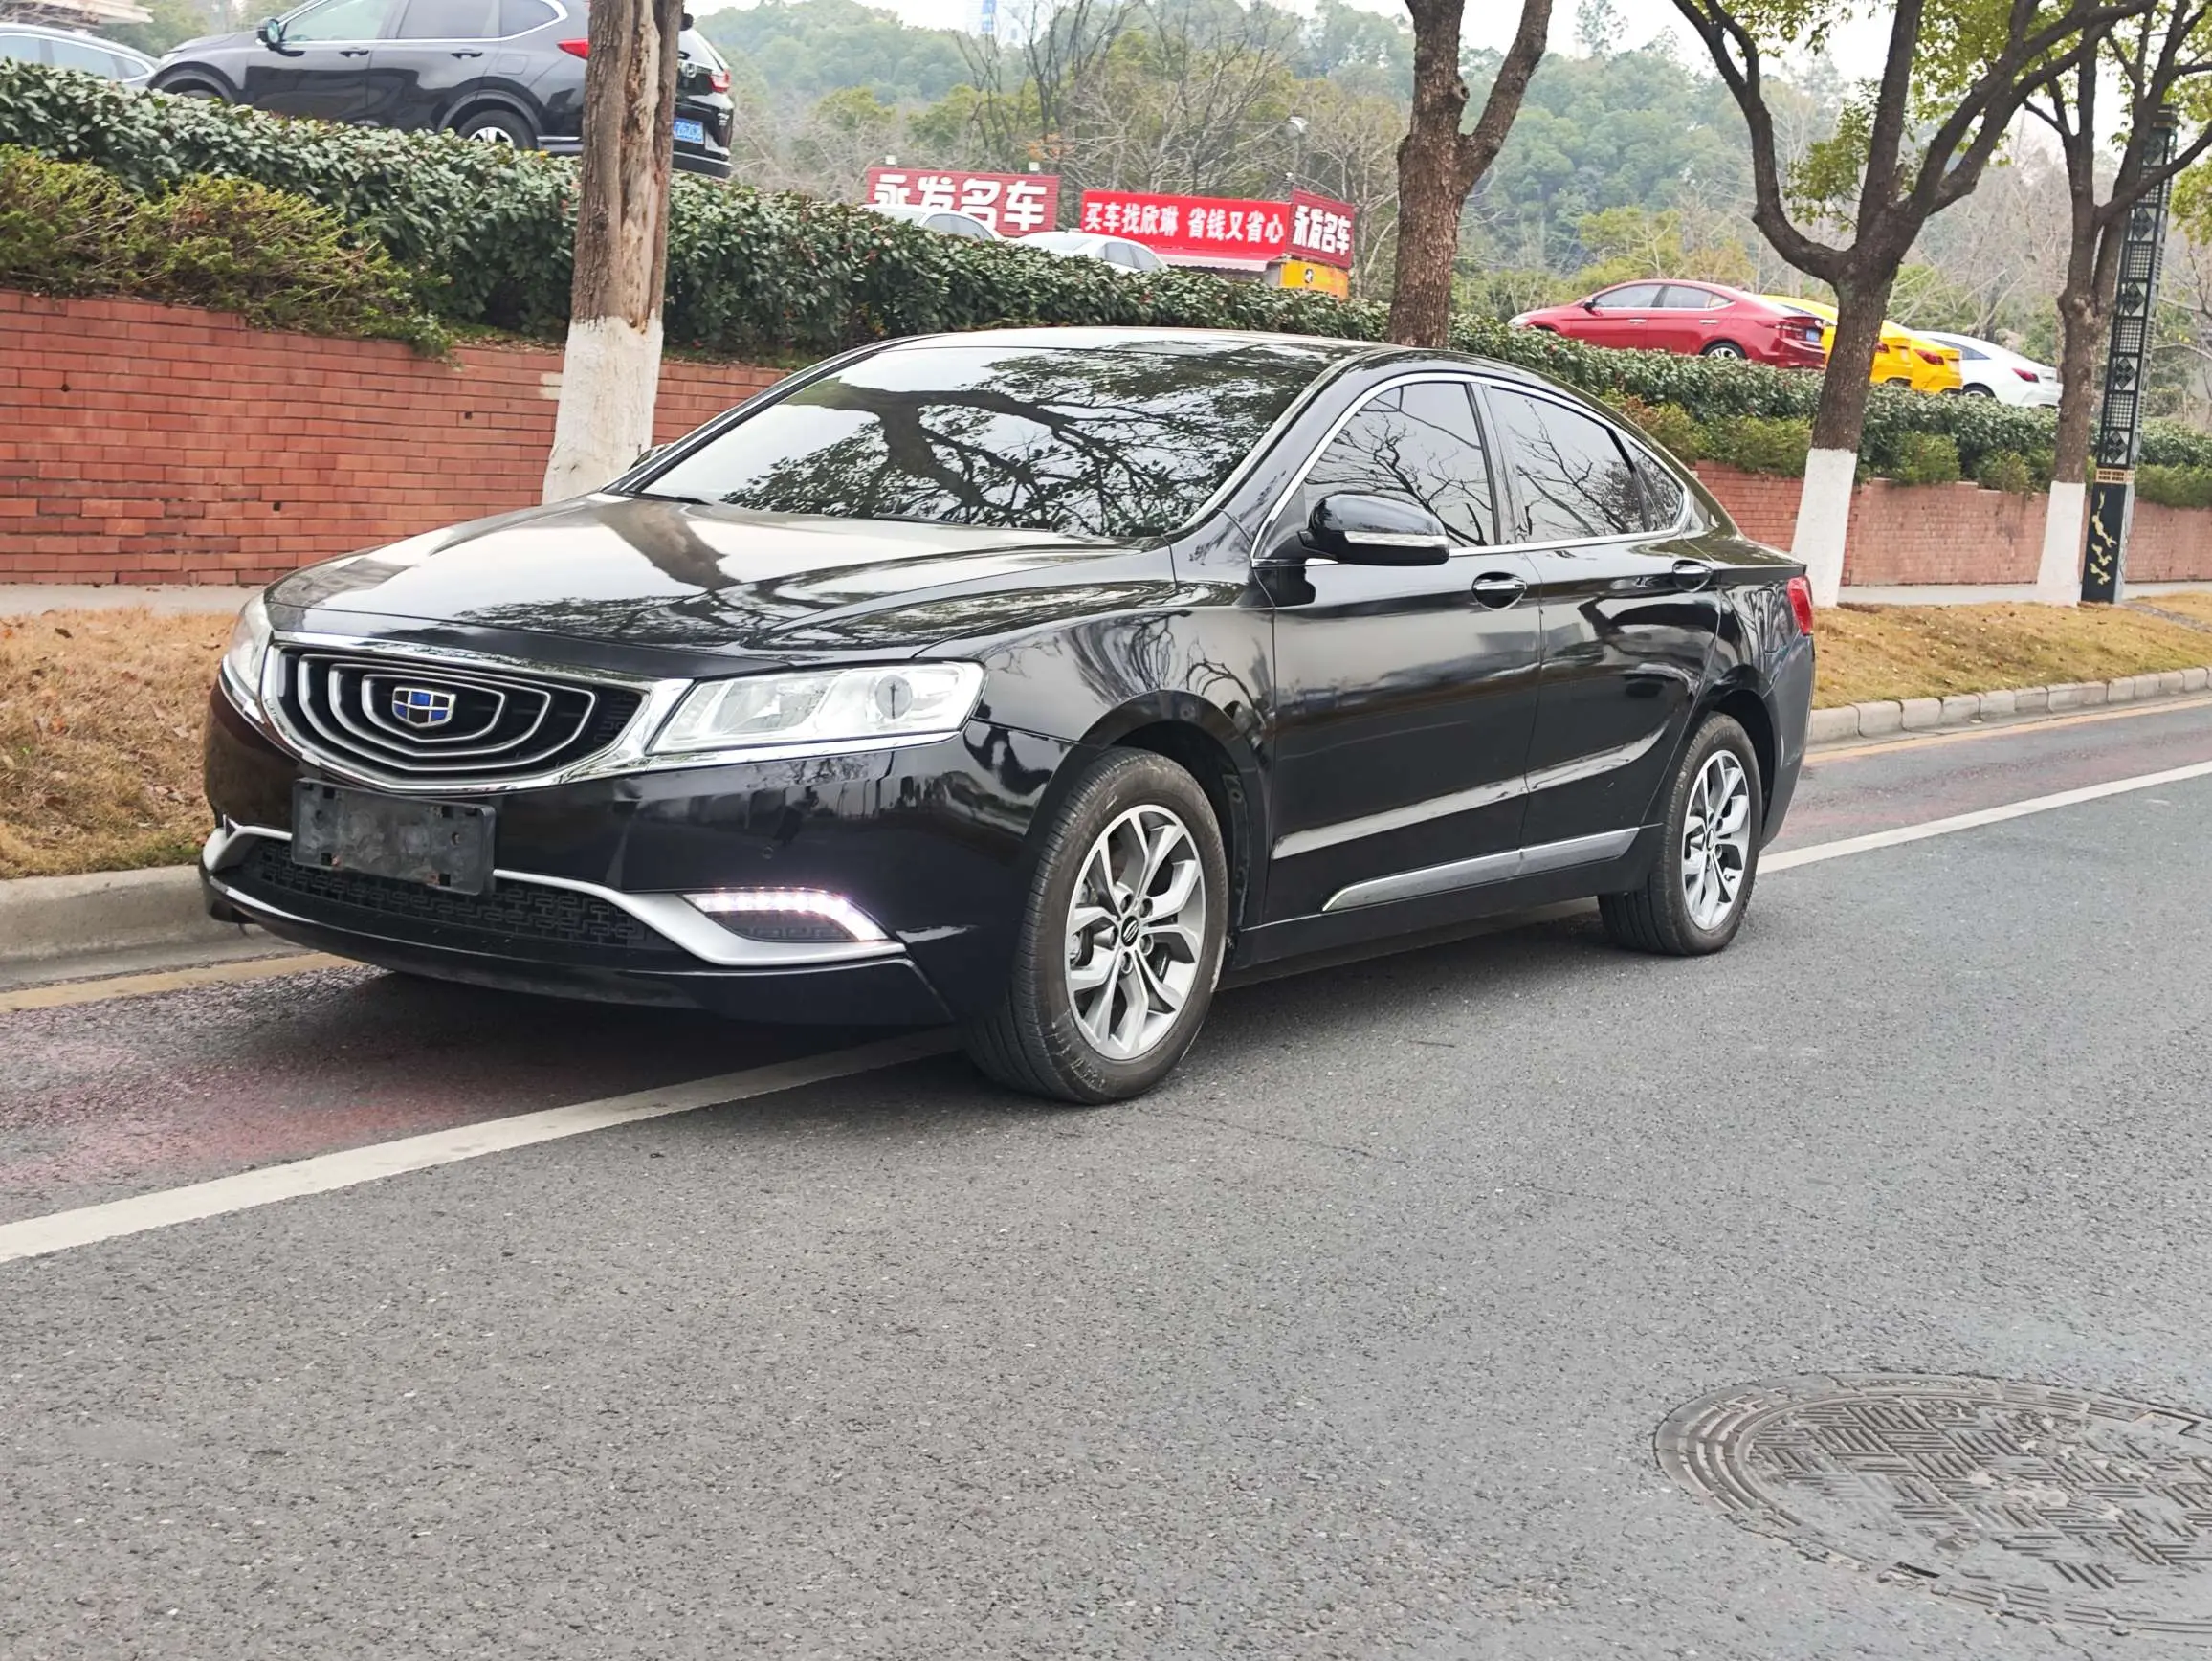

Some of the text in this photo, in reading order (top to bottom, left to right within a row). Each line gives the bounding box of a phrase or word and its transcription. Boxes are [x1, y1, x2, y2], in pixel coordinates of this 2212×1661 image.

[874, 173, 1048, 232] 永发名车
[1186, 206, 1285, 244] 省钱又省心
[1292, 204, 1352, 256] 永发名车
